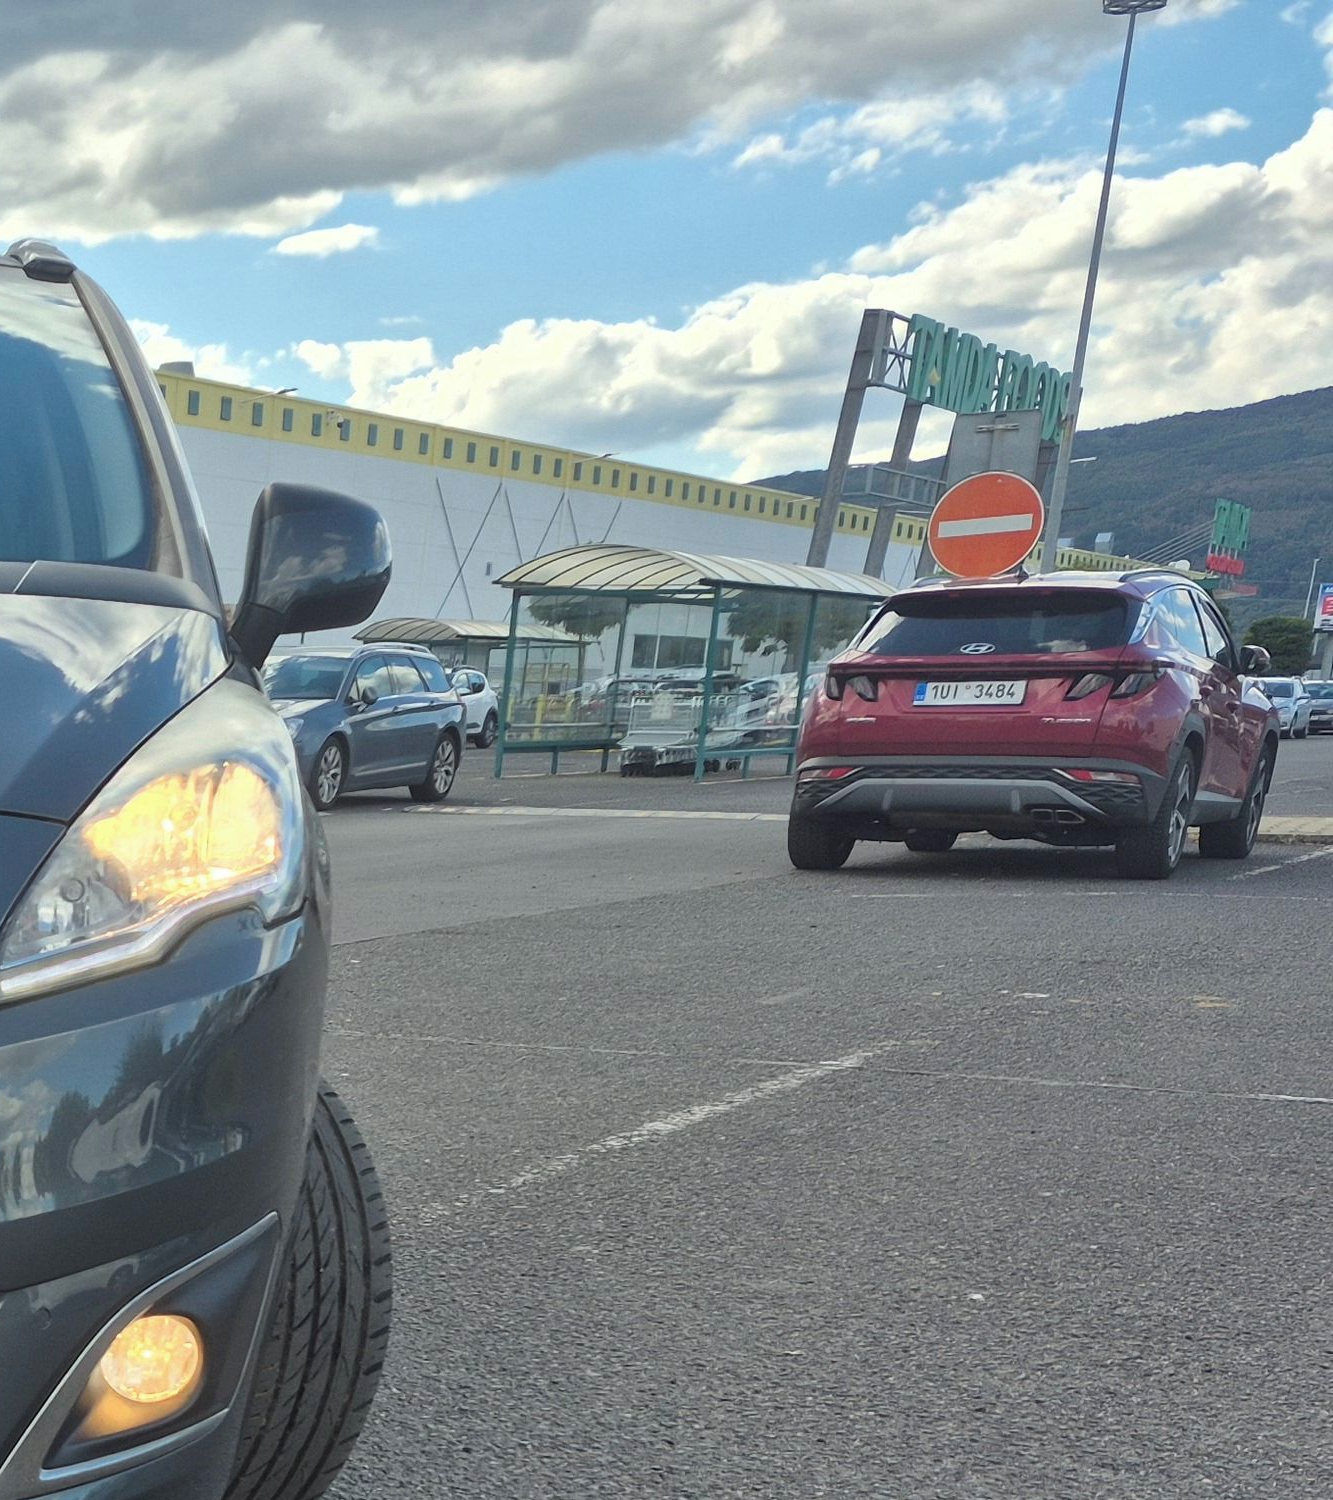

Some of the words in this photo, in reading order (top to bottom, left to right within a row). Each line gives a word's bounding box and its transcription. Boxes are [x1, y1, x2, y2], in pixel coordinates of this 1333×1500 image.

[908, 313, 998, 415] TAMDA
[932, 683, 958, 700] 1UI
[974, 683, 1016, 699] 3484
